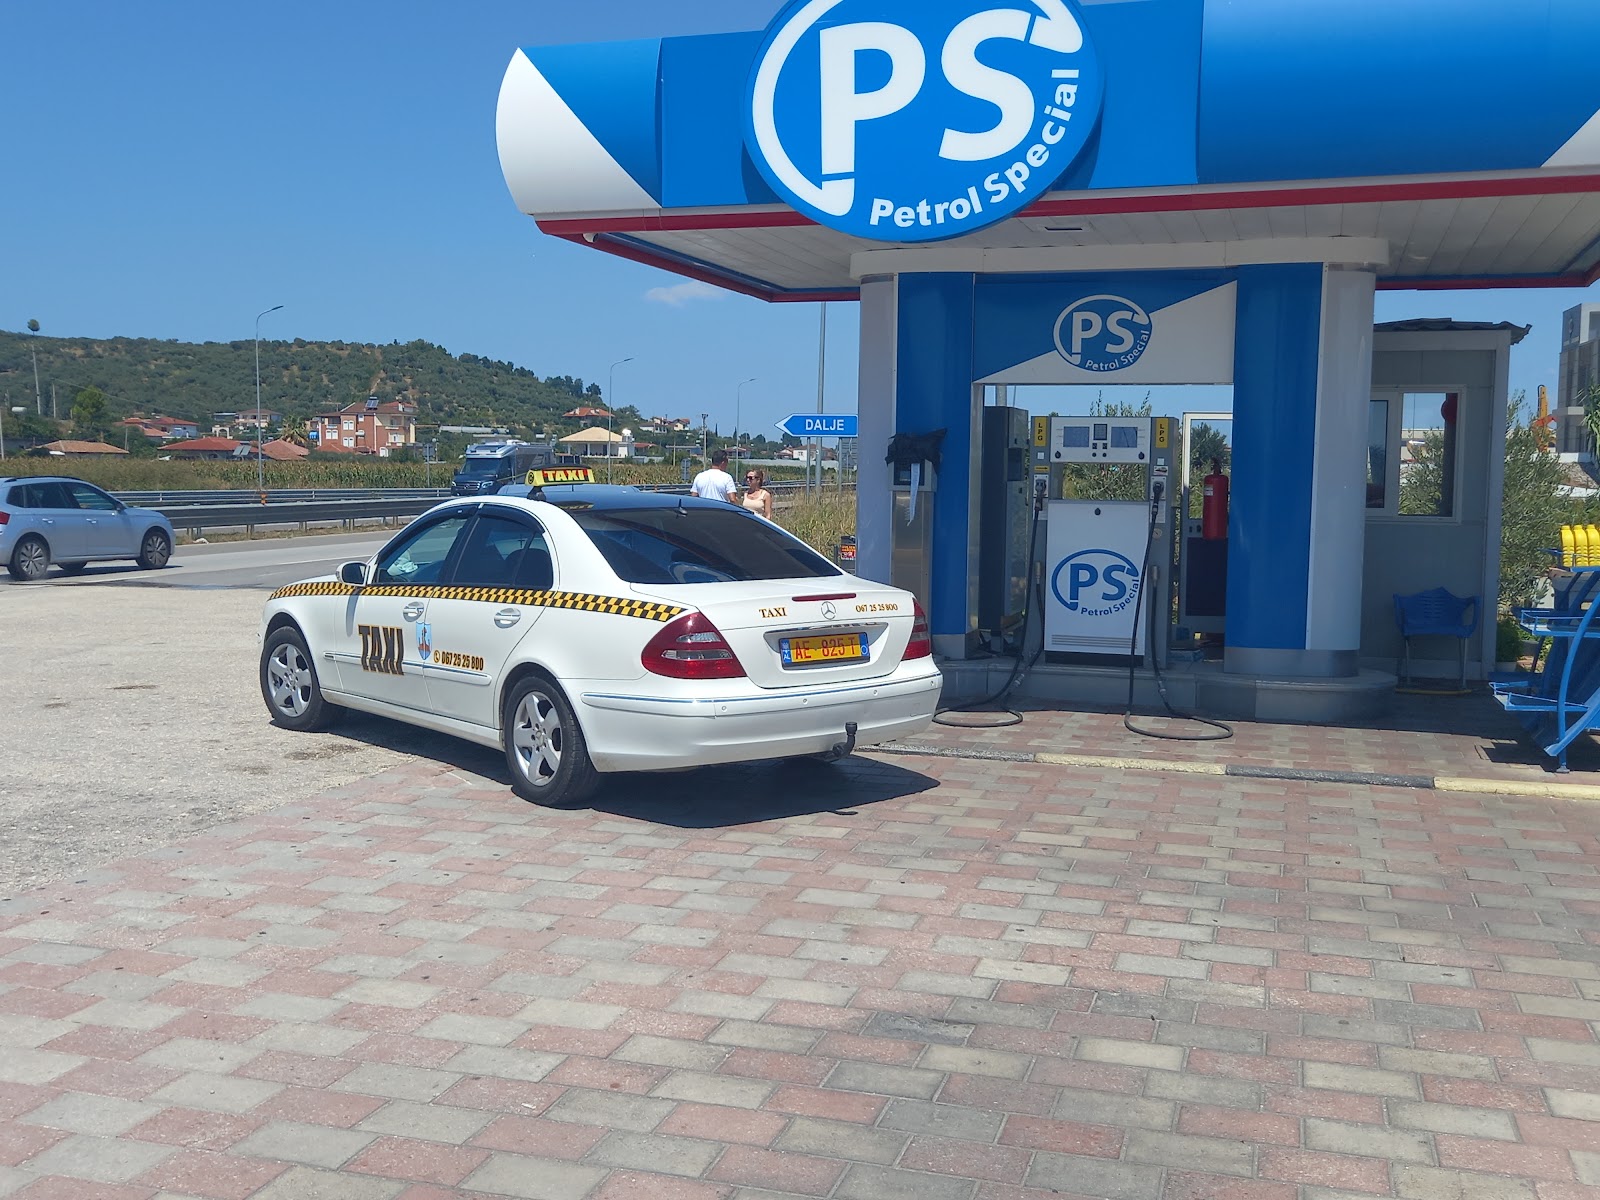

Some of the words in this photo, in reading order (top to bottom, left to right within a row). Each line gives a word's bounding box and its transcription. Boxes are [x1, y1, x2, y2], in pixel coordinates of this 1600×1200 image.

[820, 9, 1034, 175] PS
[869, 186, 984, 227] Petrol
[983, 69, 1081, 204] Special
[1072, 310, 1134, 353] PS
[1085, 359, 1120, 371] Petrol
[1120, 330, 1150, 365] Special
[805, 419, 845, 431] DALJE
[544, 470, 586, 482] TAXI
[1070, 563, 1126, 600] PS
[1081, 607, 1112, 616] Petrol
[1113, 579, 1139, 611] Special
[759, 607, 787, 618] TAXI
[358, 624, 405, 676] TAXI
[441, 651, 453, 666] 067
[453, 653, 462, 667] 25
[461, 654, 471, 669] 25
[471, 655, 484, 671] 800
[795, 640, 812, 660] AE
[821, 637, 846, 657] 825
[848, 636, 856, 655] T
